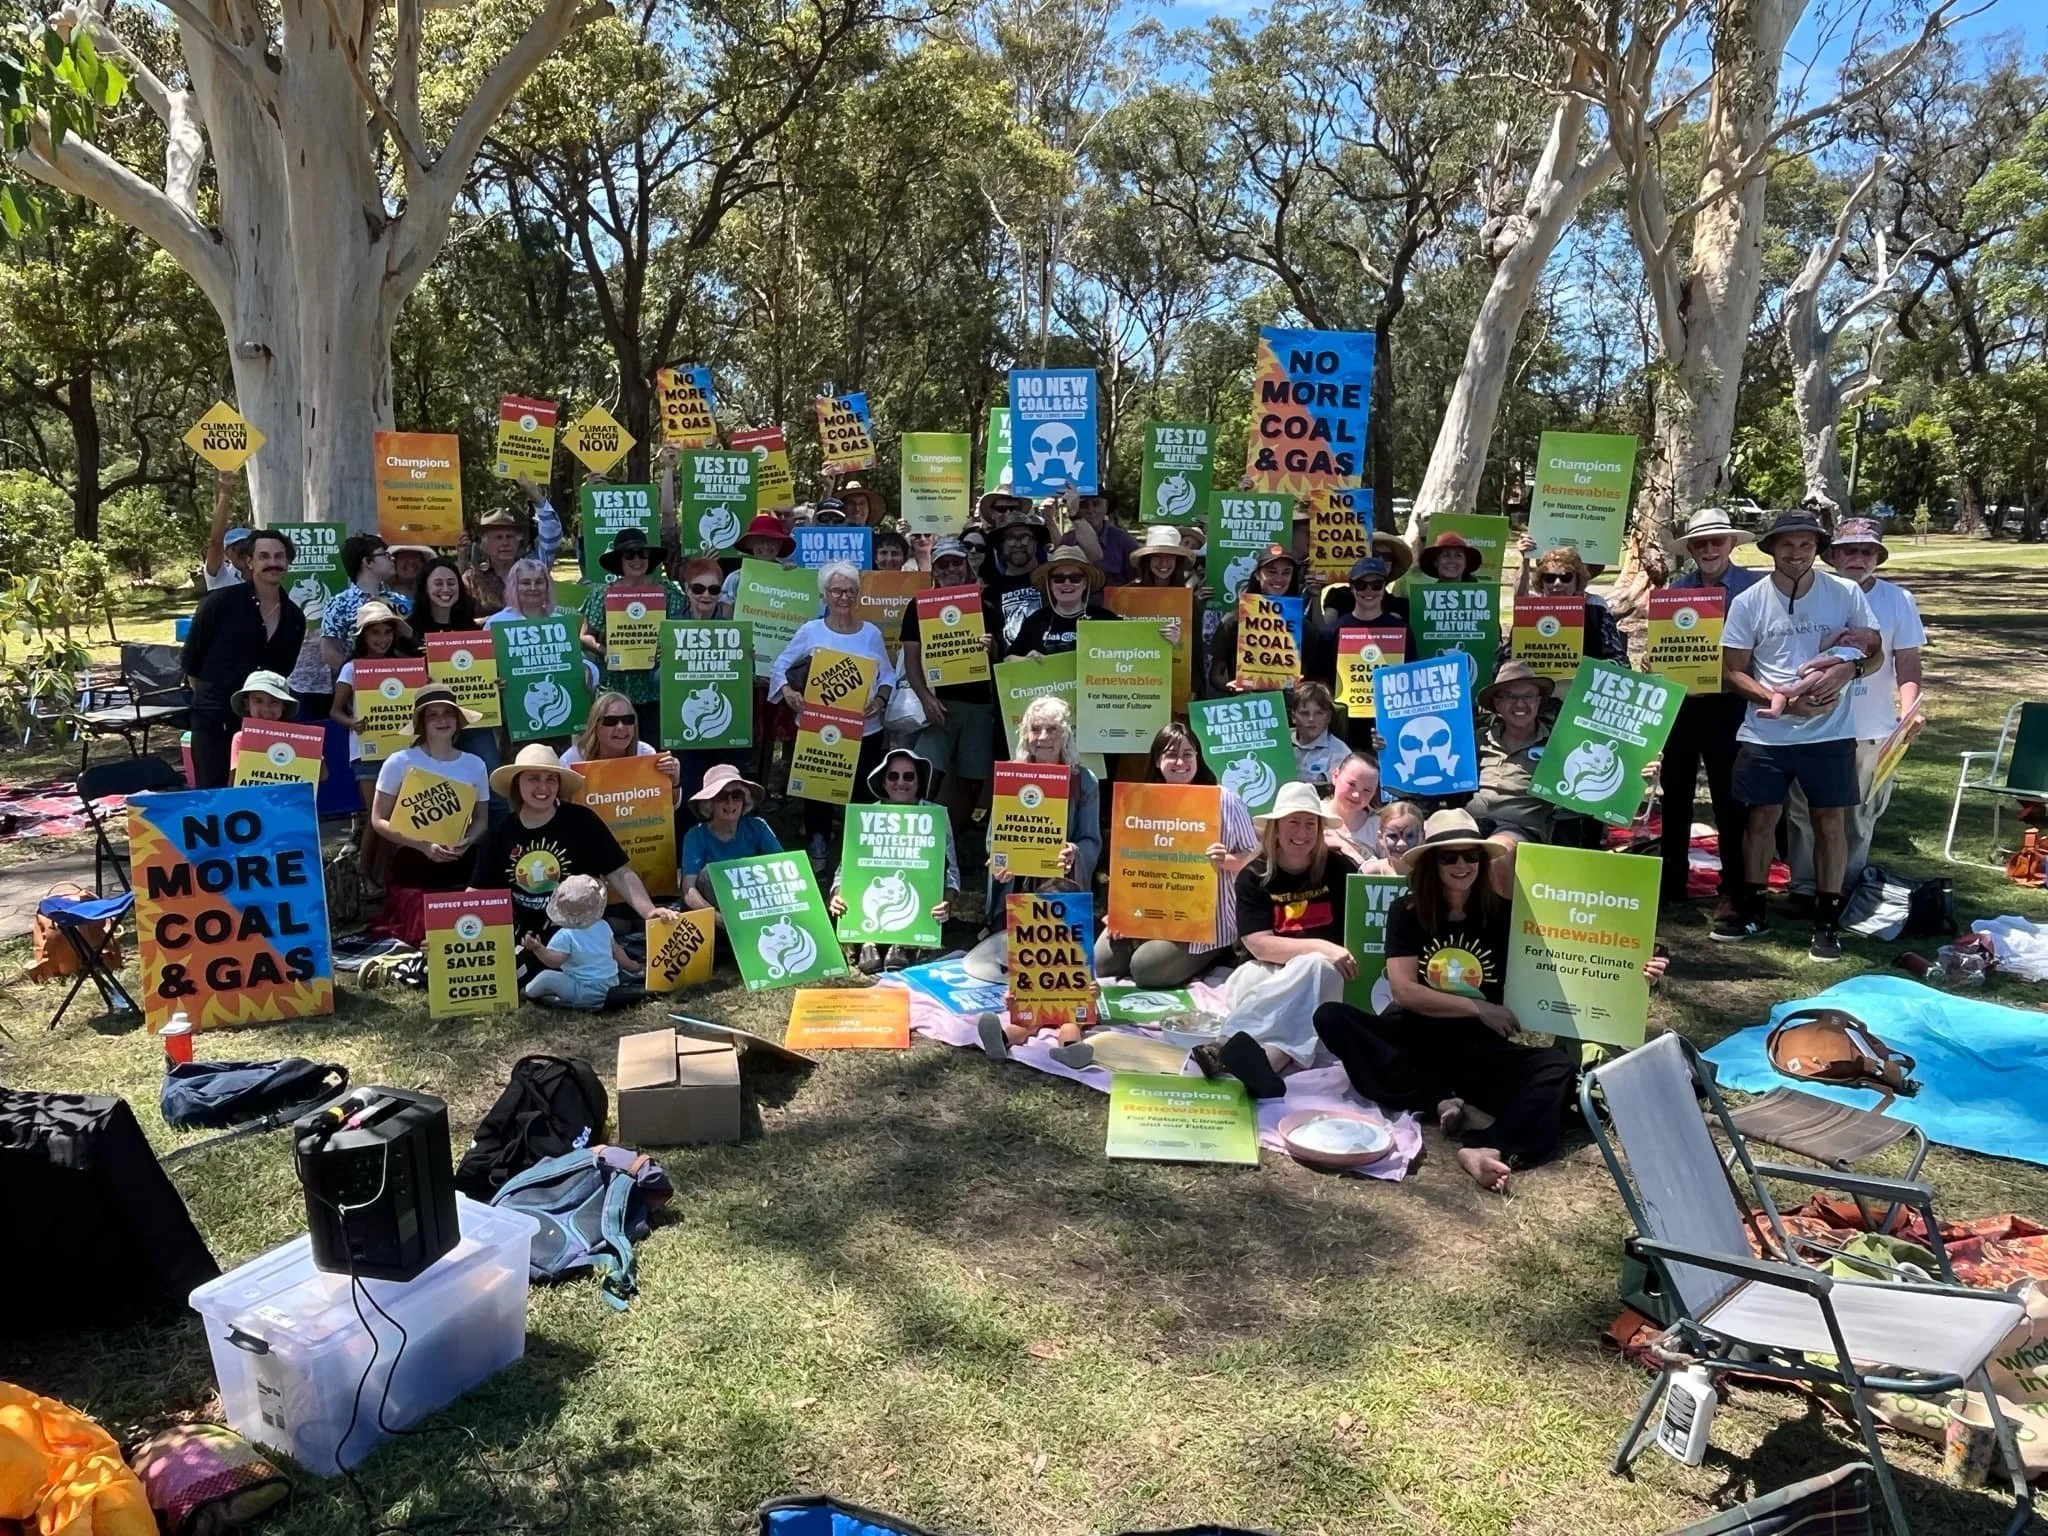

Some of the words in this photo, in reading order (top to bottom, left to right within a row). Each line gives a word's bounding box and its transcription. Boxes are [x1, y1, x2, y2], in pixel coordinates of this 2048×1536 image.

[1289, 350, 1339, 375] NO
[674, 374, 695, 385] NO
[1017, 377, 1042, 396] NO
[1047, 377, 1088, 396] NEW
[665, 388, 707, 400] MORE
[1261, 381, 1362, 408] MORE
[668, 403, 708, 414] COAL
[832, 401, 852, 413] NO
[1019, 398, 1088, 411] COAL&GAS
[682, 417, 711, 429] GAS
[824, 412, 864, 427] MORE
[578, 425, 618, 433] CLIMATE
[827, 427, 865, 440] COAL
[1156, 428, 1184, 444] YES
[1186, 429, 1206, 445] TO
[1260, 415, 1356, 443] COAL
[203, 438, 247, 450] NOW
[579, 440, 619, 451] NOW
[841, 439, 869, 451] GAS
[387, 456, 449, 469] Champions
[694, 456, 724, 473] YES
[727, 457, 748, 473] TO
[1255, 448, 1278, 471] &
[1284, 449, 1355, 476] GAS
[1550, 458, 1622, 474] Champions
[411, 469, 427, 479] for
[694, 475, 750, 484] PROTECTING
[1574, 474, 1593, 485] for
[704, 484, 740, 494] NATURE
[1542, 484, 1621, 499] Renewables
[592, 491, 623, 508] YES
[625, 491, 647, 507] TO
[1329, 495, 1354, 507] NO
[594, 508, 651, 517] PROTECTING
[1221, 499, 1256, 518] YES
[1258, 501, 1281, 518] TO
[1316, 512, 1366, 525] MORE
[314, 528, 336, 544] TO
[802, 533, 825, 549] NO
[828, 533, 864, 549] NEW
[1318, 528, 1365, 542] COAL
[1315, 547, 1328, 559] &
[1332, 546, 1366, 559] GAS
[749, 582, 810, 602] Champions
[1423, 590, 1460, 609] YES
[1462, 590, 1488, 609] TO
[769, 600, 786, 609] for
[1259, 601, 1284, 615] NO
[1424, 610, 1491, 621] PROTECTING
[1245, 617, 1295, 633] MORE
[1436, 621, 1478, 632] NATURE
[504, 626, 542, 645] YES
[542, 624, 567, 642] TO
[674, 628, 711, 648] YES
[714, 628, 740, 648] TO
[1246, 634, 1294, 650] COAL
[1660, 636, 1709, 644] HEALTHY,
[509, 643, 572, 657] PROTECTING
[675, 649, 743, 660] PROTECTING
[1089, 648, 1161, 661] Champions
[1524, 643, 1570, 651] HEALTHY,
[1650, 645, 1718, 654] AFFORDABLE
[687, 660, 731, 671] NATURE
[1243, 652, 1256, 664] &
[1260, 652, 1295, 667] GAS
[1691, 654, 1719, 662] NOW
[810, 657, 853, 687] CLIMATE
[1116, 662, 1134, 672] for
[822, 664, 858, 690] ACTION
[1086, 675, 1163, 686] Renewables
[1381, 672, 1409, 695] NO
[1413, 663, 1459, 688] NEW
[473, 692, 496, 700] NOW
[820, 672, 864, 706] NOW
[1590, 667, 1636, 700] YES
[1638, 683, 1668, 711] TO
[1384, 685, 1461, 711] COAL&GAS
[1203, 702, 1242, 724] YES
[1244, 700, 1272, 718] TO
[1583, 691, 1663, 726] PROTECTING
[1207, 718, 1279, 736] PROTECTING
[1592, 707, 1642, 735] NATURE
[1221, 730, 1267, 745] NATURE
[831, 769, 853, 779] NOW
[401, 781, 451, 808] CLIMATE
[414, 788, 457, 814] ACTION
[586, 786, 661, 806] Champions
[410, 800, 462, 829] NOW
[616, 805, 635, 817] for
[860, 812, 900, 833] YES
[904, 813, 933, 834] TO
[1005, 814, 1053, 826] HEALTHY,
[1125, 815, 1207, 833] Champions
[183, 810, 262, 850] NO
[997, 824, 1062, 835] AFFORDABLE
[859, 834, 935, 847] PROTECTING
[994, 834, 1035, 844] ENERGY
[1037, 836, 1063, 845] NOW
[1154, 834, 1175, 848] for
[872, 847, 921, 859] NATURE
[147, 850, 308, 900] MORE
[724, 865, 769, 888] YES
[768, 860, 799, 881] TO
[1122, 868, 1135, 877] For
[1171, 871, 1204, 881] Climate
[731, 880, 808, 901] PROTECTING
[1131, 881, 1147, 889] and
[1166, 882, 1194, 892] Future
[750, 892, 798, 910] NATURE
[1531, 883, 1640, 911] Champions
[428, 901, 461, 909] PROTECT
[1032, 901, 1066, 920] NO
[1569, 907, 1596, 925] for
[156, 902, 309, 949] COAL
[1016, 924, 1084, 943] MORE
[1523, 920, 1641, 949] Renewables
[444, 940, 496, 955] SOLAR
[651, 917, 690, 968] CLIMATE
[663, 922, 697, 968] ACTION
[447, 954, 496, 970] SAVES
[664, 930, 705, 983] NOW
[1019, 948, 1083, 967] COAL
[1525, 945, 1543, 958] For
[1545, 949, 1587, 964] Nature,
[1589, 954, 1634, 970] Climate
[158, 963, 197, 999] &
[206, 947, 315, 991] GAS
[1536, 961, 1557, 972] and
[1559, 966, 1580, 976] our
[1582, 967, 1620, 981] Future
[449, 973, 496, 985] NUCLEAR
[1016, 973, 1032, 990] &
[1039, 972, 1086, 990] GAS
[449, 984, 497, 999] COSTS
[1129, 1088, 1232, 1101] Champions
[1124, 1104, 1240, 1116] Renewables
